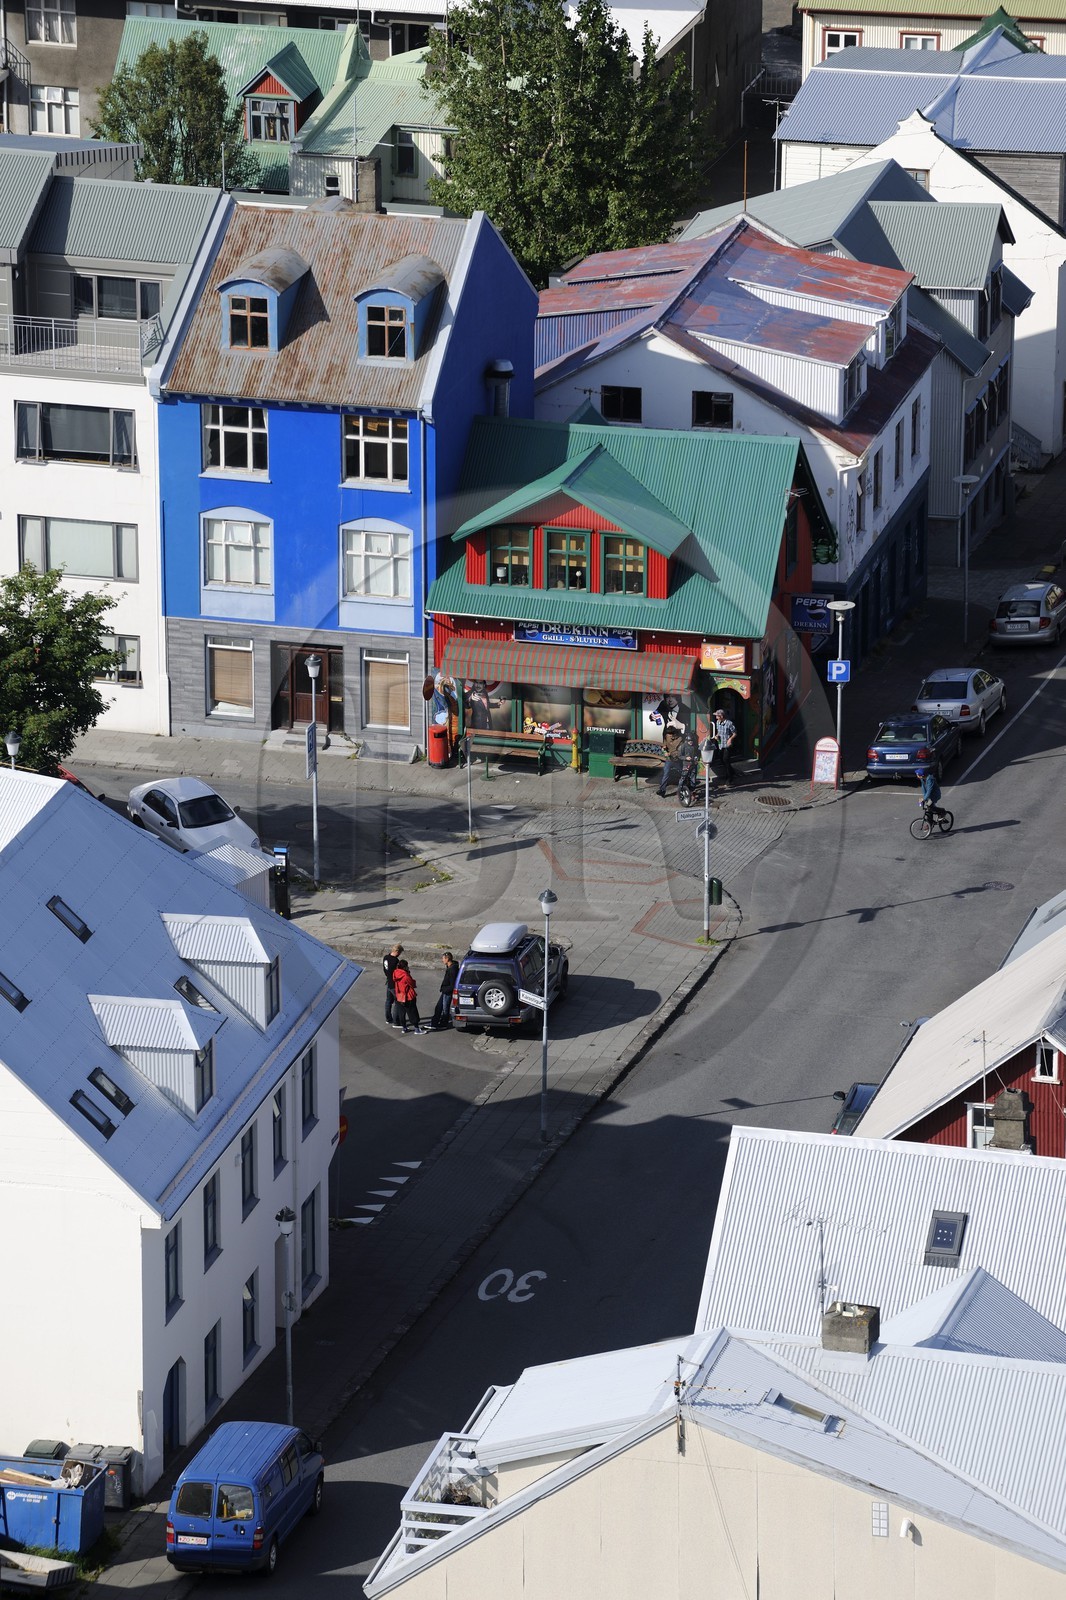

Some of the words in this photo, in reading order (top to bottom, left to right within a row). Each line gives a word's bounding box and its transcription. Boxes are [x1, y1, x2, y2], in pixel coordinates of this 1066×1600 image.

[796, 598, 828, 607] PEPSI
[541, 623, 609, 637] DREKINN
[542, 634, 565, 642] GRILL
[832, 663, 846, 680] P
[586, 726, 626, 735] SUPERMARKET
[477, 1268, 548, 1303] 30
